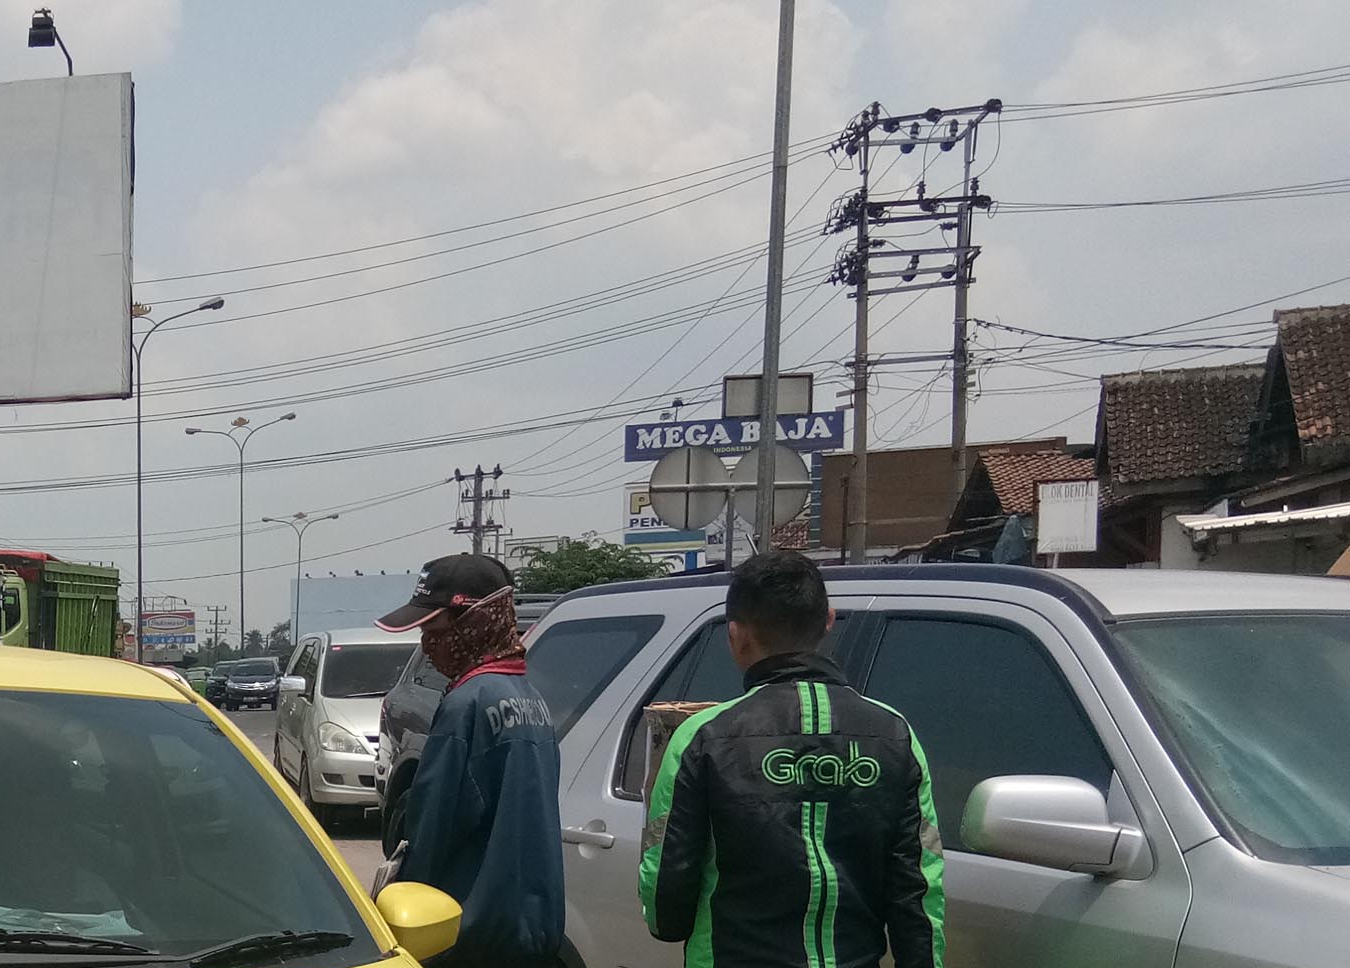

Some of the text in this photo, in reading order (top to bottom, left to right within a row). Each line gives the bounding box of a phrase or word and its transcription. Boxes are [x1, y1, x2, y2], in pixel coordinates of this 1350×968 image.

[636, 424, 731, 450] MEGA
[713, 445, 752, 454] INDONESIA
[629, 517, 668, 528] PEN
[761, 741, 881, 787] Grab
